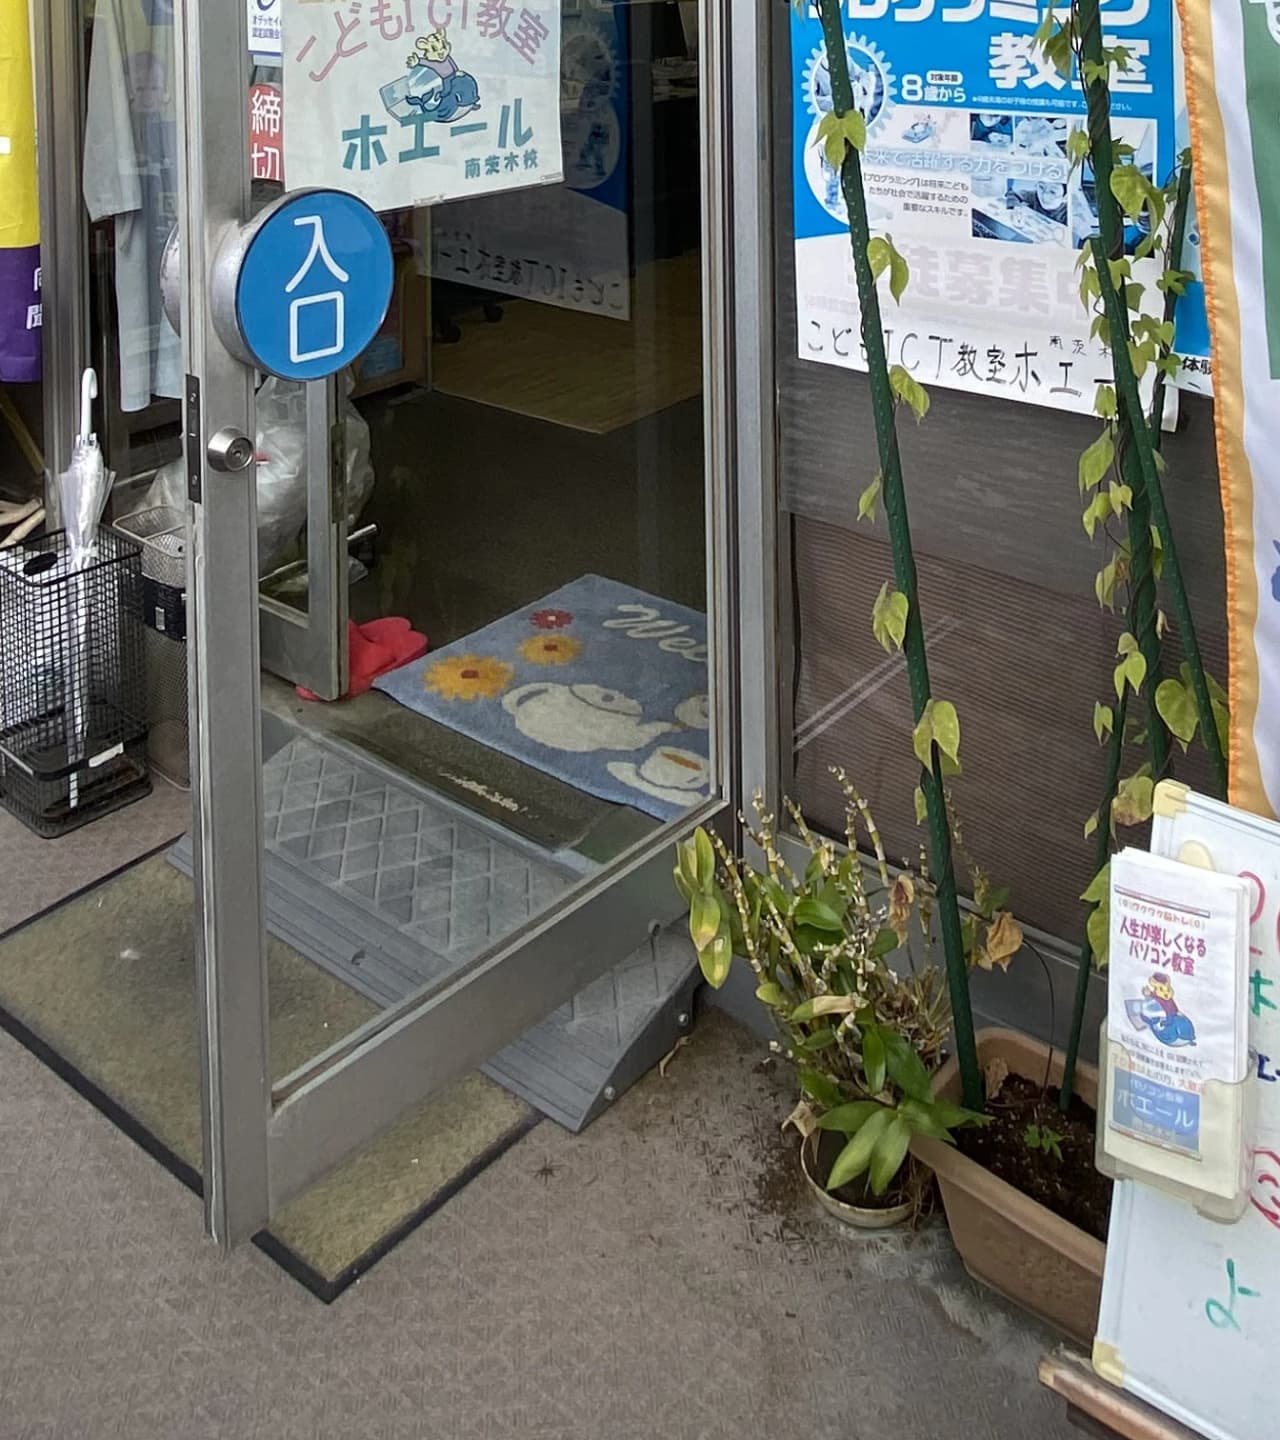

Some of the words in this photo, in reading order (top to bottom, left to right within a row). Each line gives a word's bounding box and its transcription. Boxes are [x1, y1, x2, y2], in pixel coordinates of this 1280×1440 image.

[900, 73, 923, 103] 8
[923, 86, 967, 103] 歳から
[341, 97, 534, 172] ホエール
[464, 147, 539, 180] 南茨木校
[285, 215, 350, 364] 入口
[1119, 915, 1208, 958] 人生が楽しくなる
[1128, 944, 1195, 977] パソコン教室
[1116, 1088, 1195, 1129] ホエール
